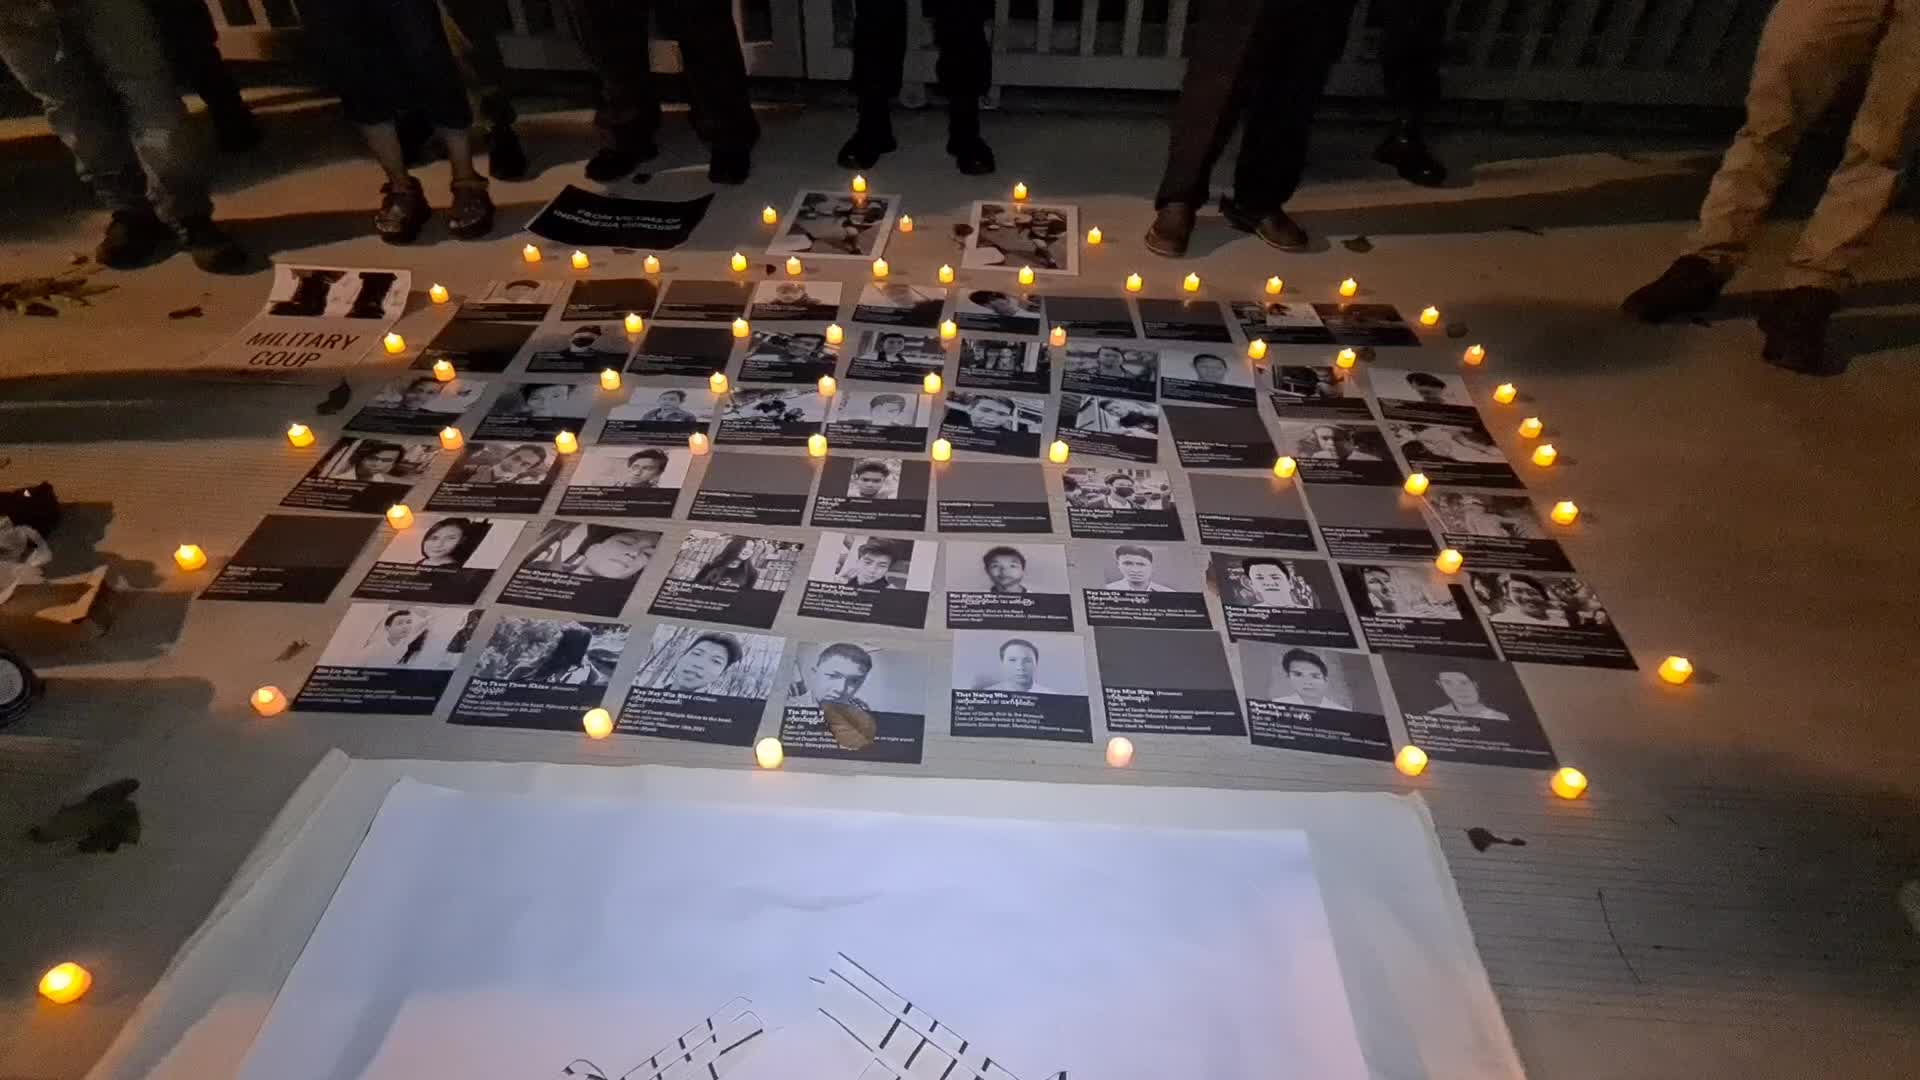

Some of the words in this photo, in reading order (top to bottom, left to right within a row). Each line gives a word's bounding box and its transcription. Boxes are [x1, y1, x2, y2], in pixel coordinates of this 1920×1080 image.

[553, 208, 619, 228] INDONESIA
[577, 208, 612, 220] FROM
[246, 332, 360, 350] MILITARY
[249, 351, 320, 367] COUP
